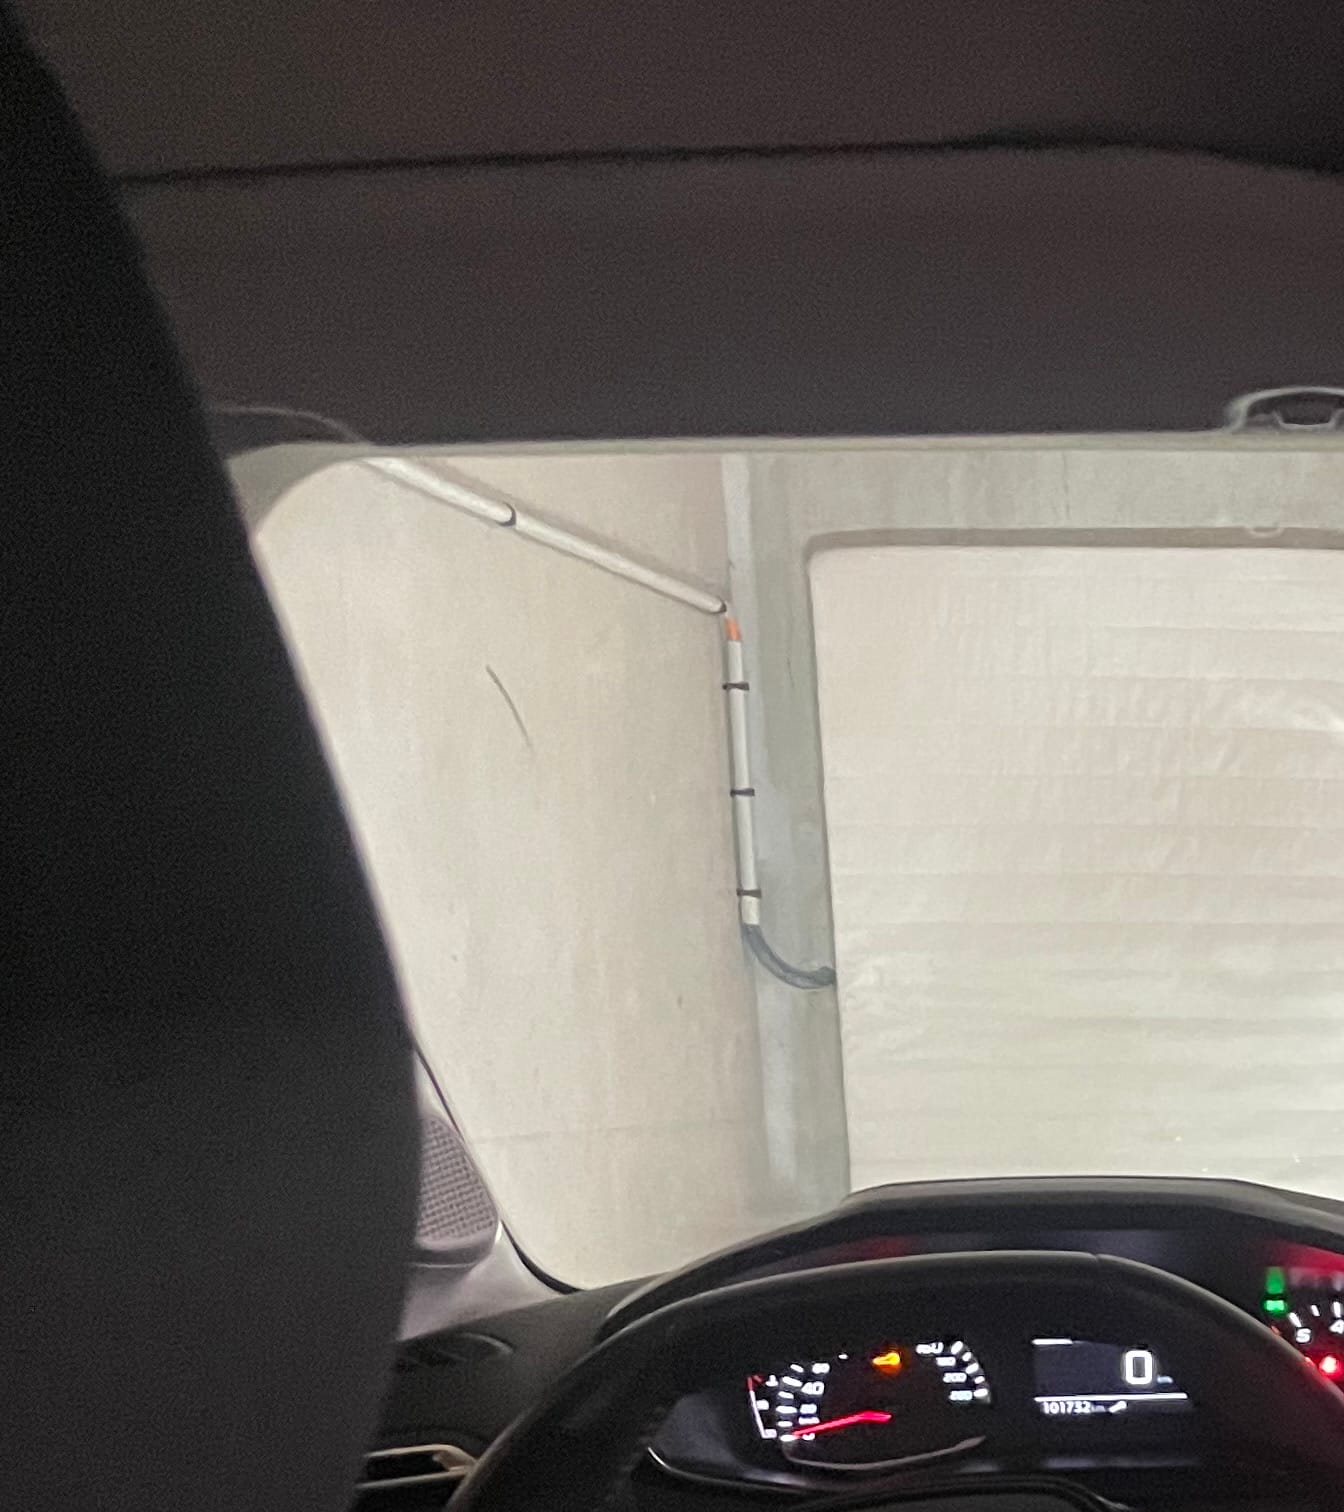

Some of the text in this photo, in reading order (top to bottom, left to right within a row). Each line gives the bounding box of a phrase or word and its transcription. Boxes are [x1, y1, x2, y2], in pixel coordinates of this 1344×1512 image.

[1329, 1319, 1344, 1334] 4
[1295, 1328, 1311, 1343] 5
[1125, 1350, 1152, 1385] 0
[802, 1381, 825, 1396] 40
